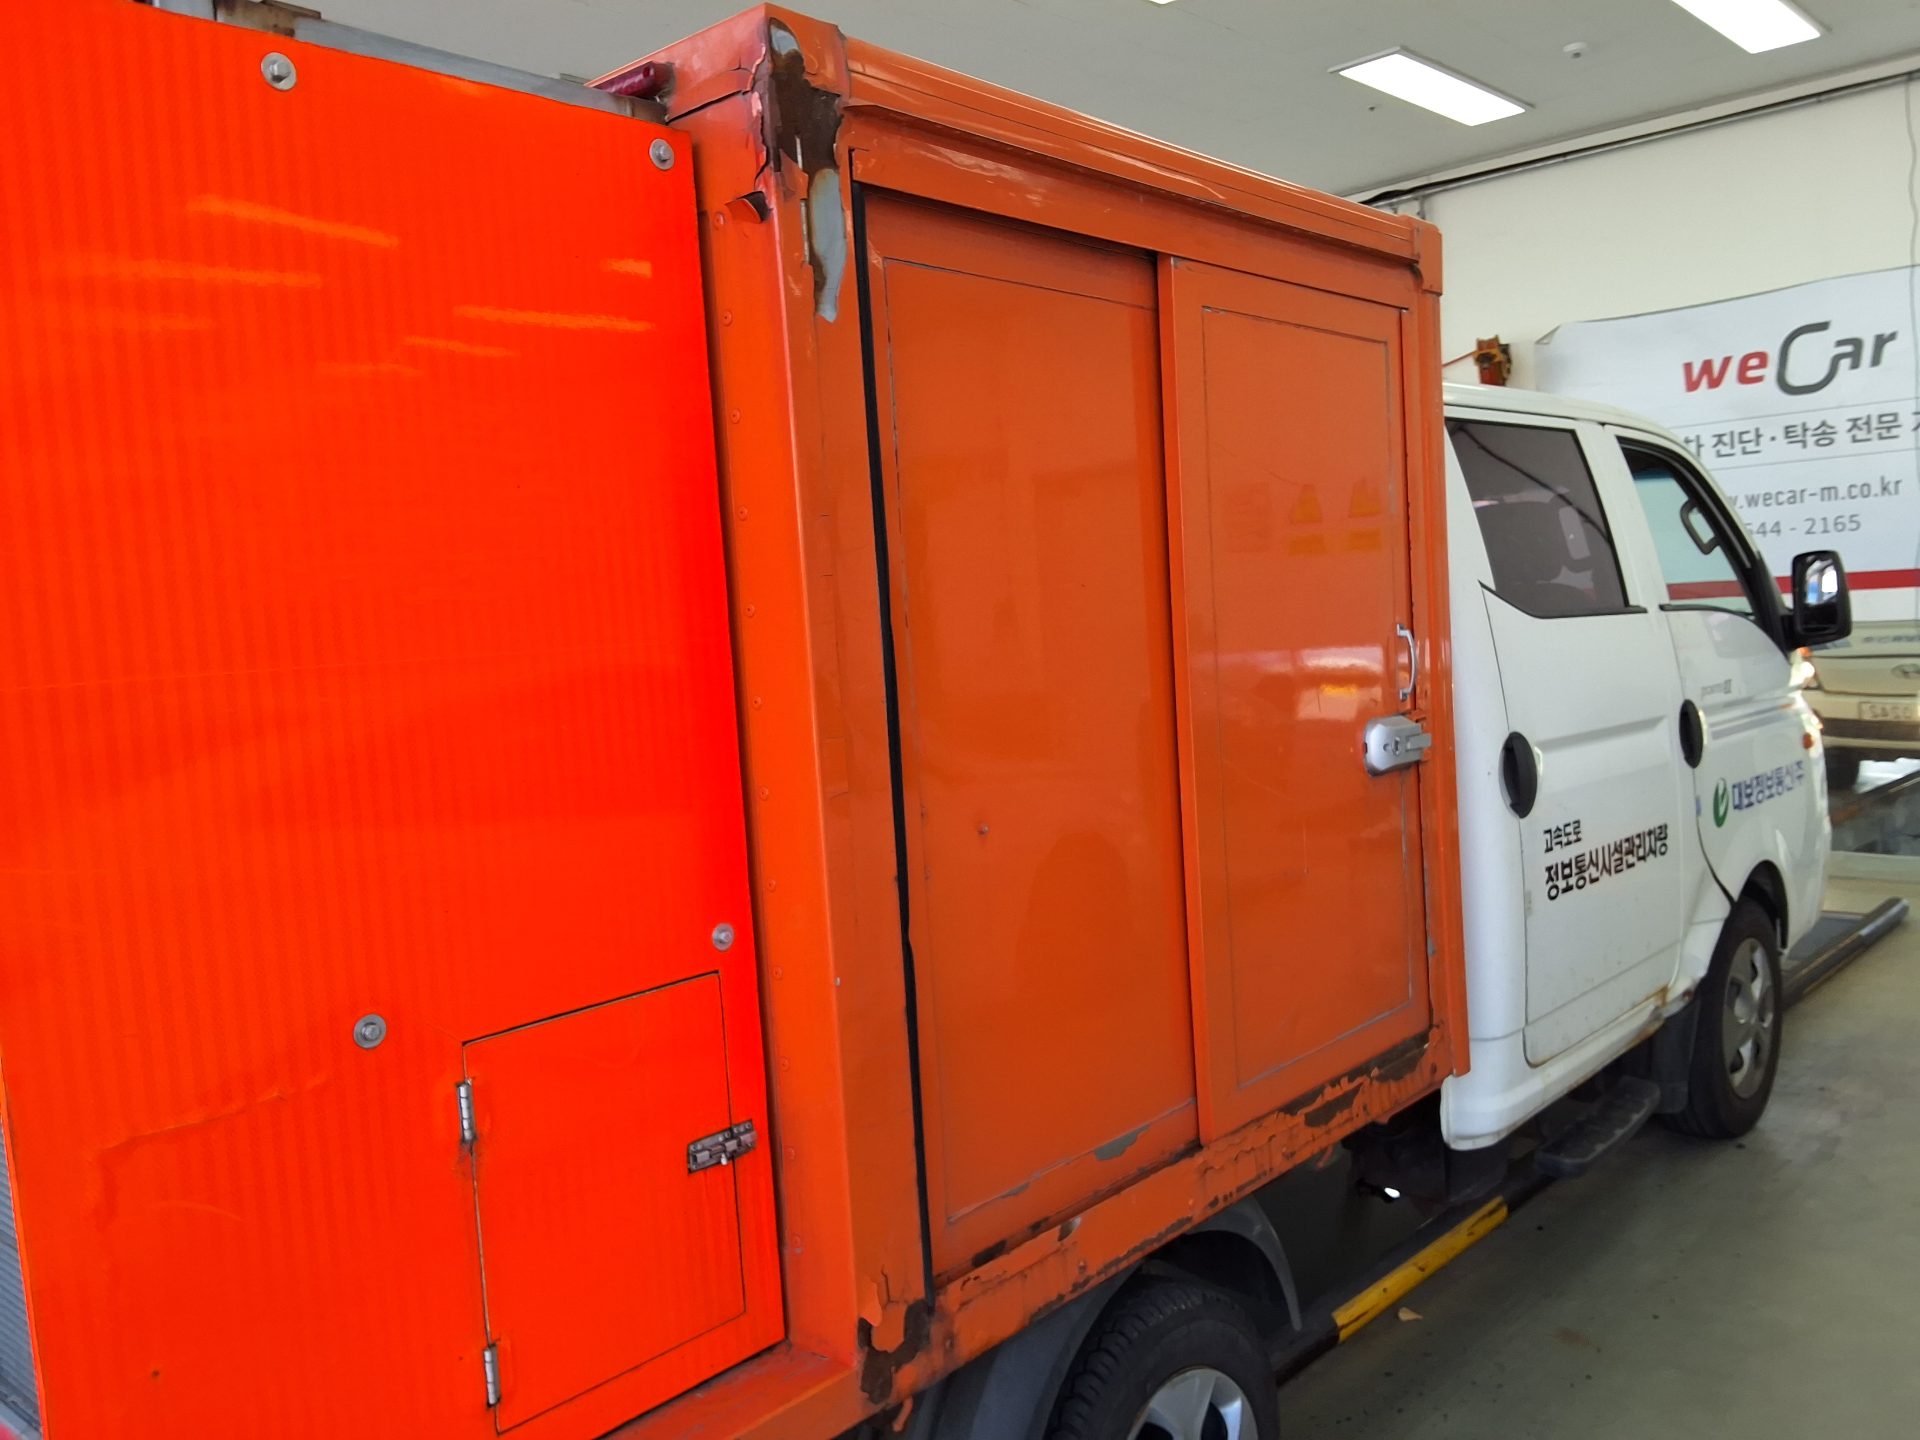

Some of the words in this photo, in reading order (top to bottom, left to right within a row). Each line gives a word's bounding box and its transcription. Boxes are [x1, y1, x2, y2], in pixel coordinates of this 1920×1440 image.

[1845, 412, 1902, 443] 전문
[1803, 513, 1861, 535] 2165
[1543, 819, 1582, 853] 고속도로
[1545, 822, 1668, 901] 정보통신시설관리차량
